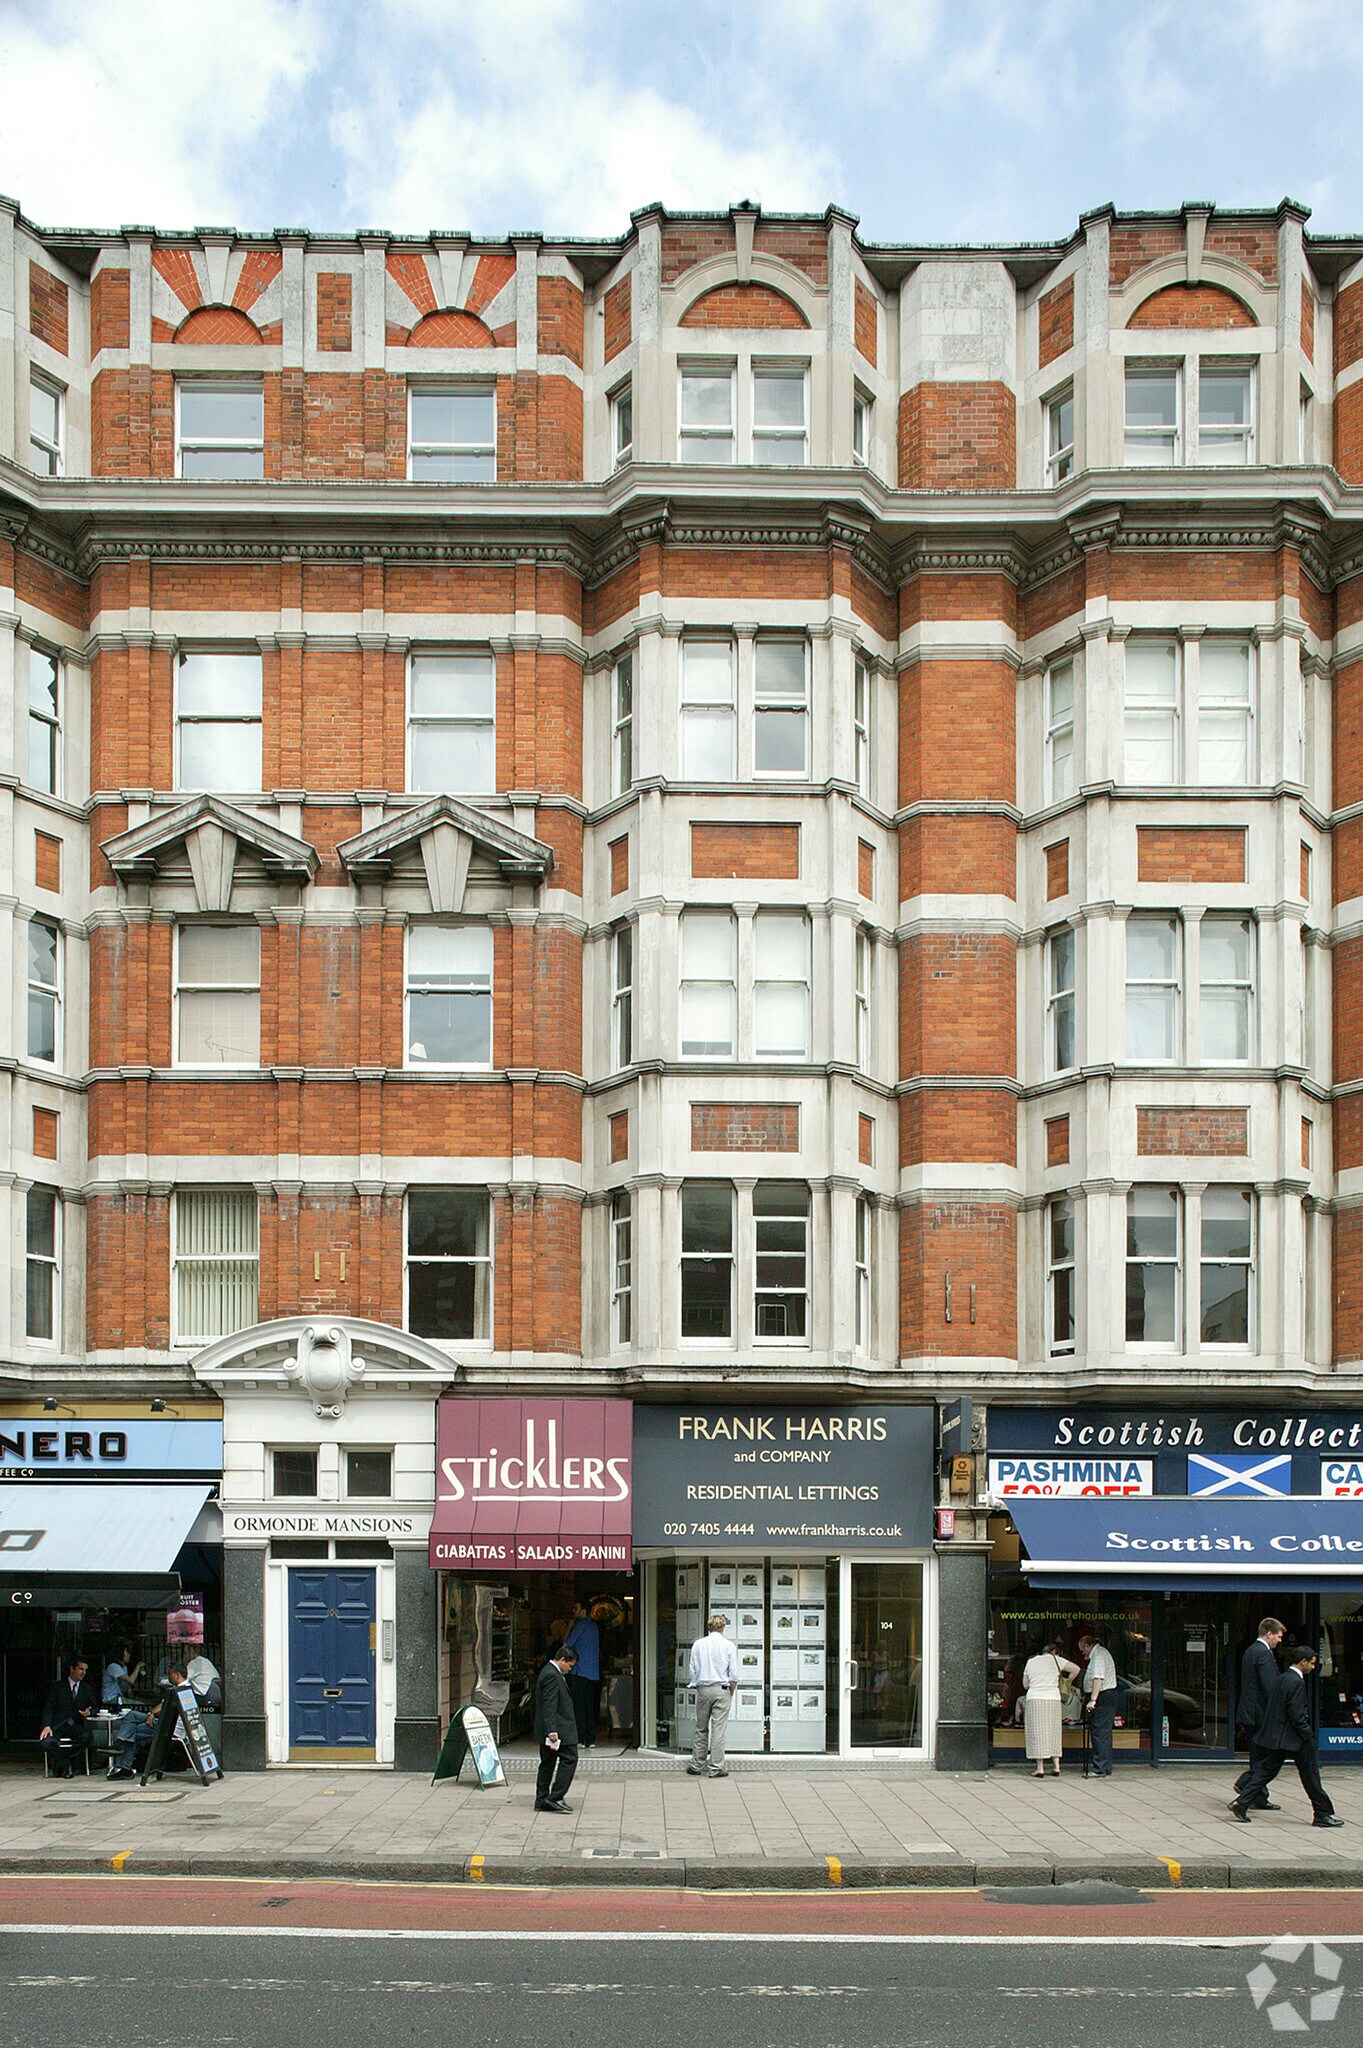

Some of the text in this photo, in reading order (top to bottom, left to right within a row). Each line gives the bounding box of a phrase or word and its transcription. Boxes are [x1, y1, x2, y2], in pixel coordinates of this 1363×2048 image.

[679, 1416, 887, 1441] FRANK HARRIS
[1055, 1417, 1363, 1447] Scottish Collect
[0, 1431, 127, 1459] NERO
[734, 1450, 832, 1463] and COMPANY
[998, 1461, 1143, 1483] PASHMINA
[1326, 1463, 1363, 1484] CA
[687, 1485, 879, 1501] RESIDENTIAL LETTINGS
[234, 1517, 413, 1533] ORMONDE MANSIONS
[663, 1524, 902, 1537] 020 7405 4444 www.frankharris.co.uk
[1106, 1532, 1255, 1552] Scottish
[436, 1544, 626, 1560] CIABATTAS SALADS PANINI
[1000, 1611, 1141, 1621] www.cashmerehouse.co.uk
[881, 1622, 893, 1630] 104
